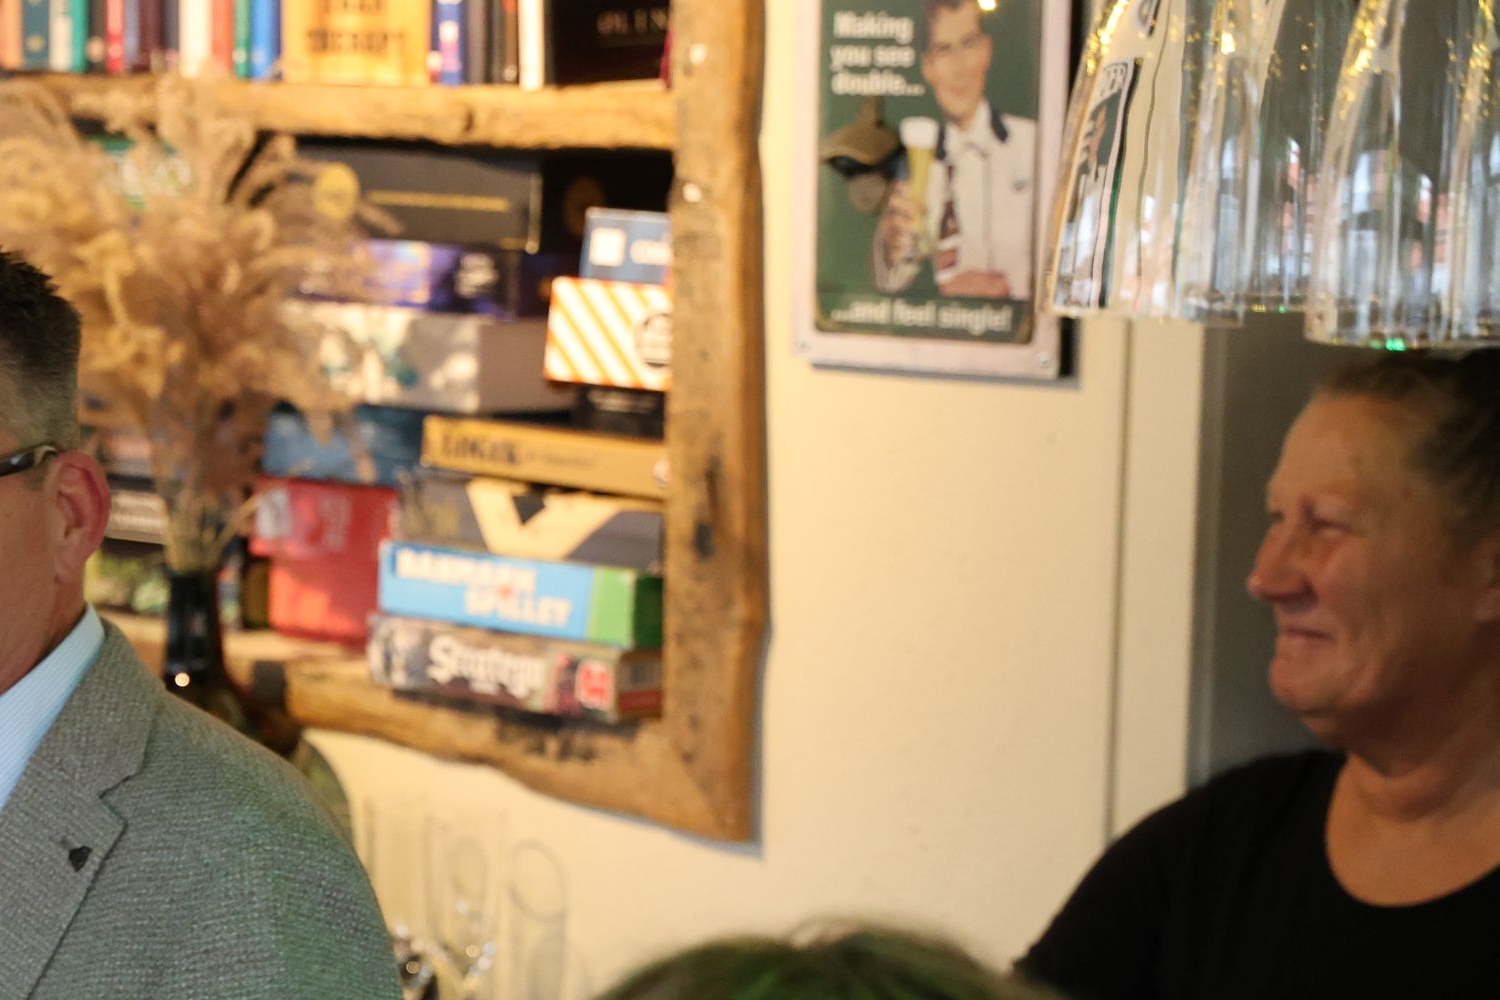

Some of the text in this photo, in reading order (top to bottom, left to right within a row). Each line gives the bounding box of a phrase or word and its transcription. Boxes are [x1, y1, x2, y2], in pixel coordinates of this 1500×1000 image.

[833, 11, 913, 44] Making
[830, 45, 915, 71] you see
[893, 299, 936, 327] feel
